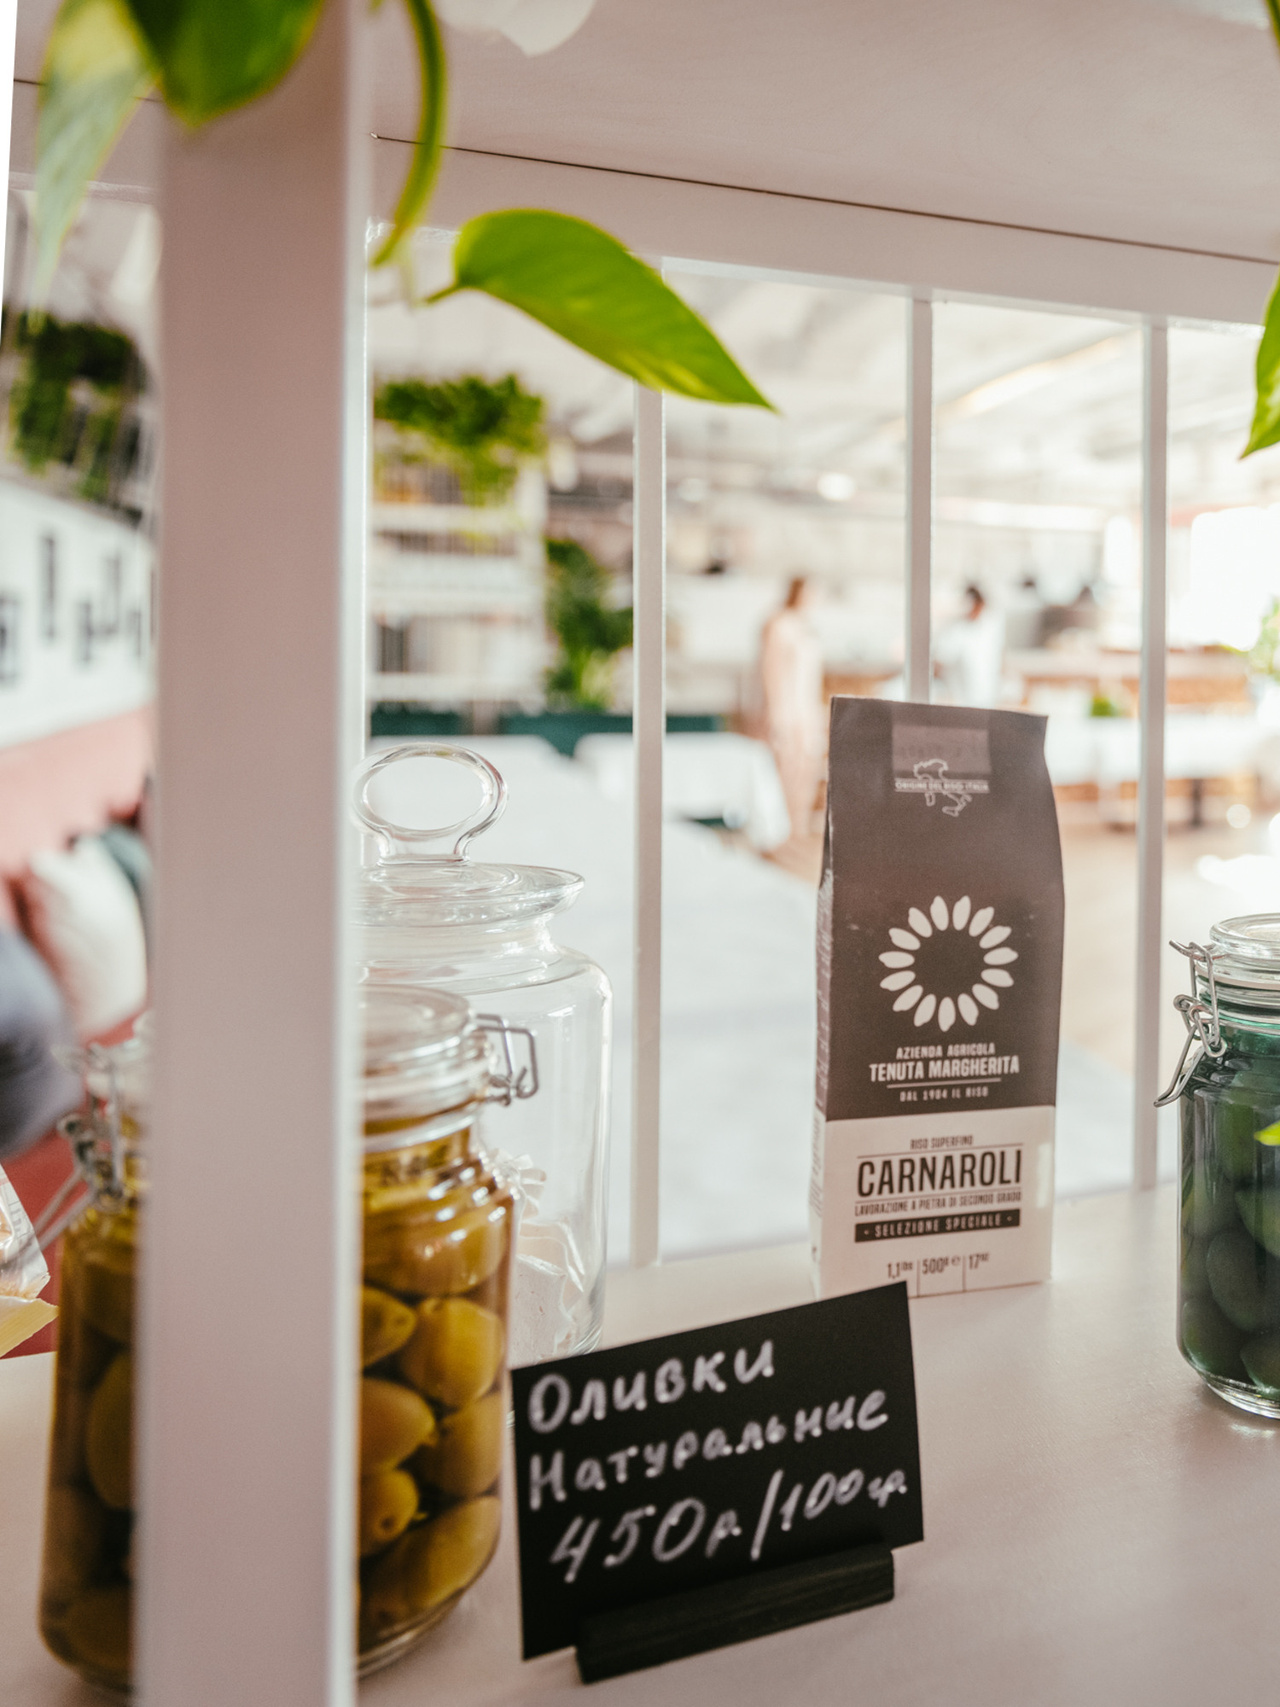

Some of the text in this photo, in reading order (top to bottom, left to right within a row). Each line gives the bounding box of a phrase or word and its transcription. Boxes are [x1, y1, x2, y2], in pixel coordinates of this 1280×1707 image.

[896, 1042, 996, 1060] AZIENDA AGRICOLA
[869, 1055, 1020, 1082] TENUTA MARGHERITA
[931, 1135, 974, 1149] SUPERFINO
[857, 1149, 1022, 1198] CARNAROLI
[854, 1201, 908, 1217] LAVORAZIONE
[919, 1197, 946, 1210] PIETRA
[959, 1193, 994, 1207] SECONDO
[996, 1191, 1022, 1204] GRADO
[874, 1212, 1001, 1238] SELEZIONE SPECIALE
[528, 1340, 774, 1434] Оливки
